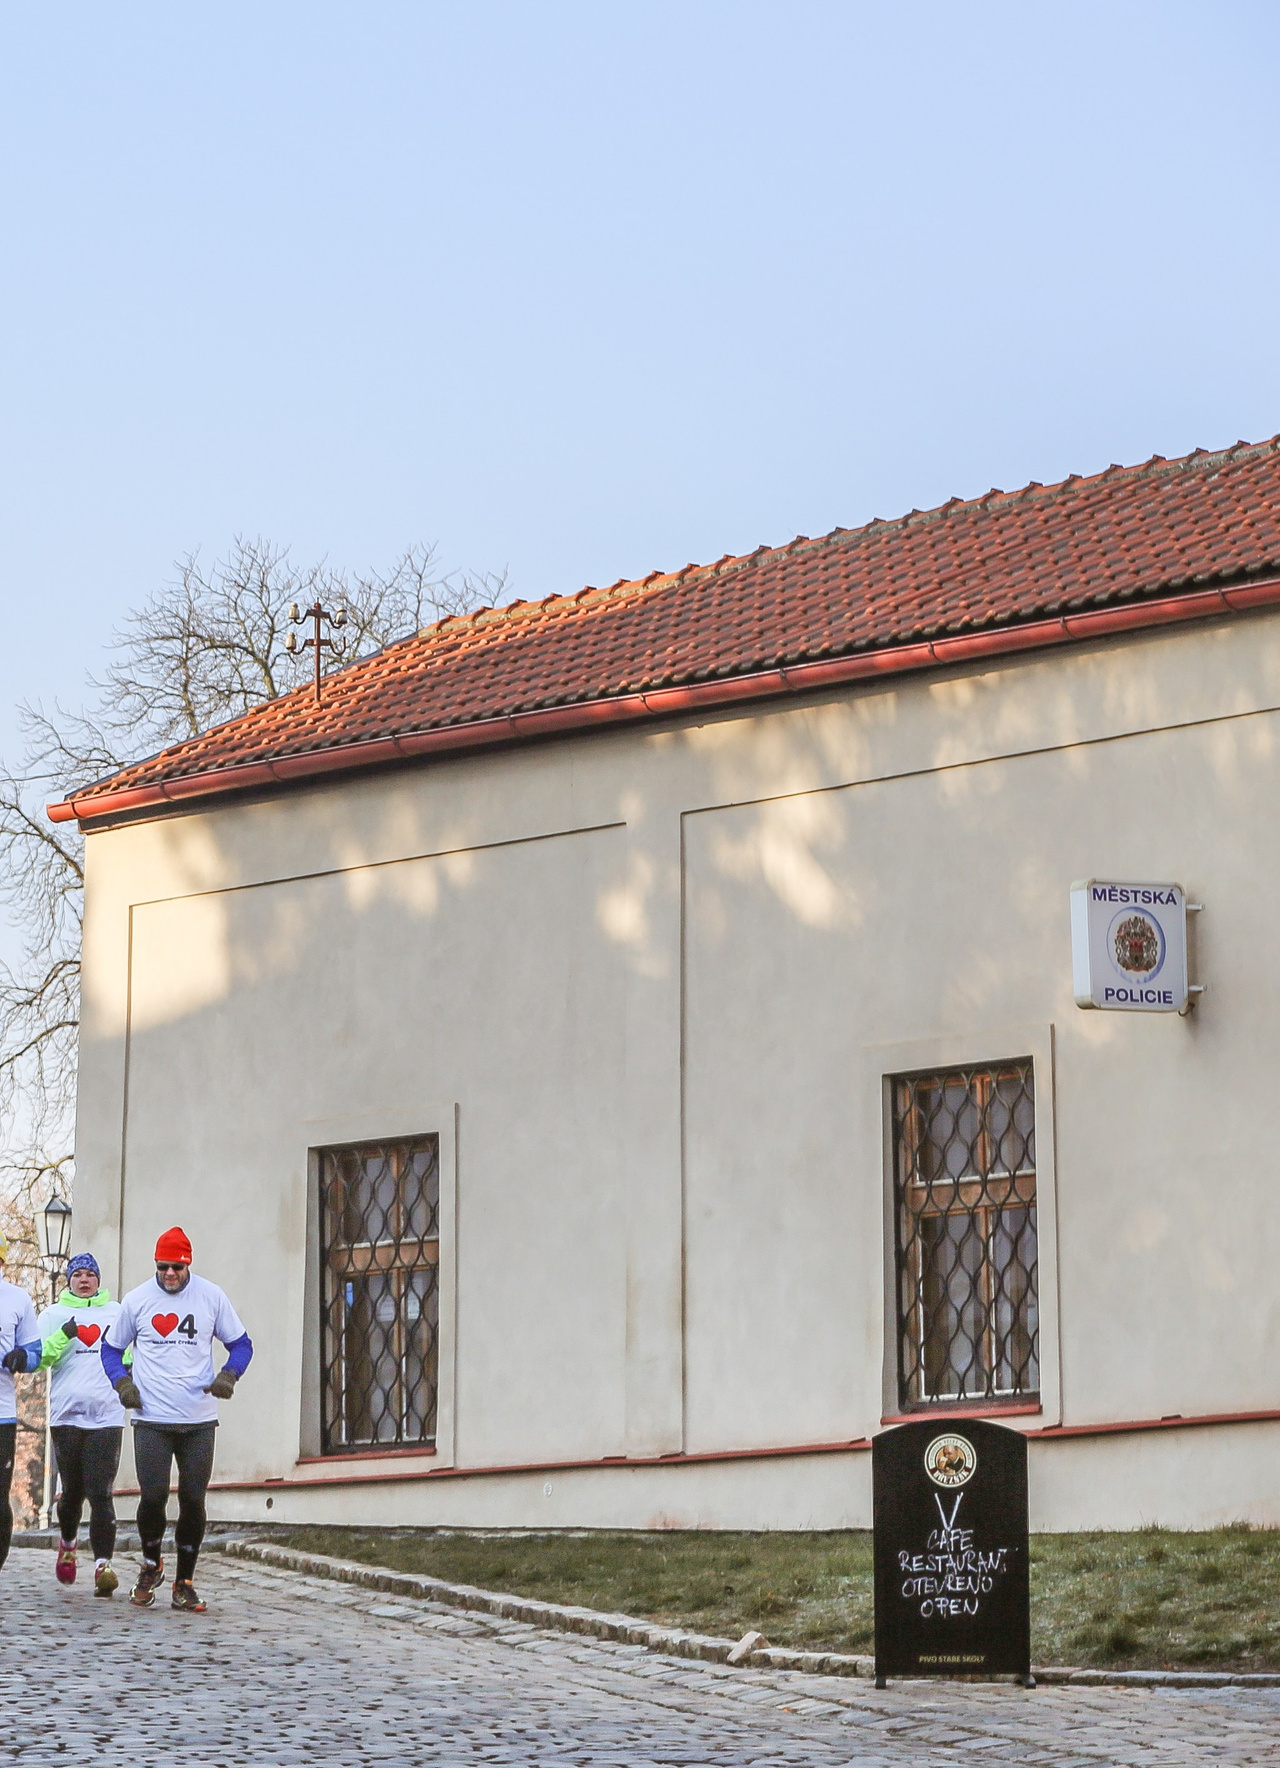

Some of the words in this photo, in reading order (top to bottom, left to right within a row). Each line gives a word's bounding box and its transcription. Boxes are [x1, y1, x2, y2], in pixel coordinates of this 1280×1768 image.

[1092, 885, 1177, 905] MĚSTSKÁ
[1104, 987, 1173, 1004] POLICIE
[177, 1313, 198, 1339] 4
[927, 1528, 974, 1551] CAFE
[921, 1597, 979, 1618] OPEN
